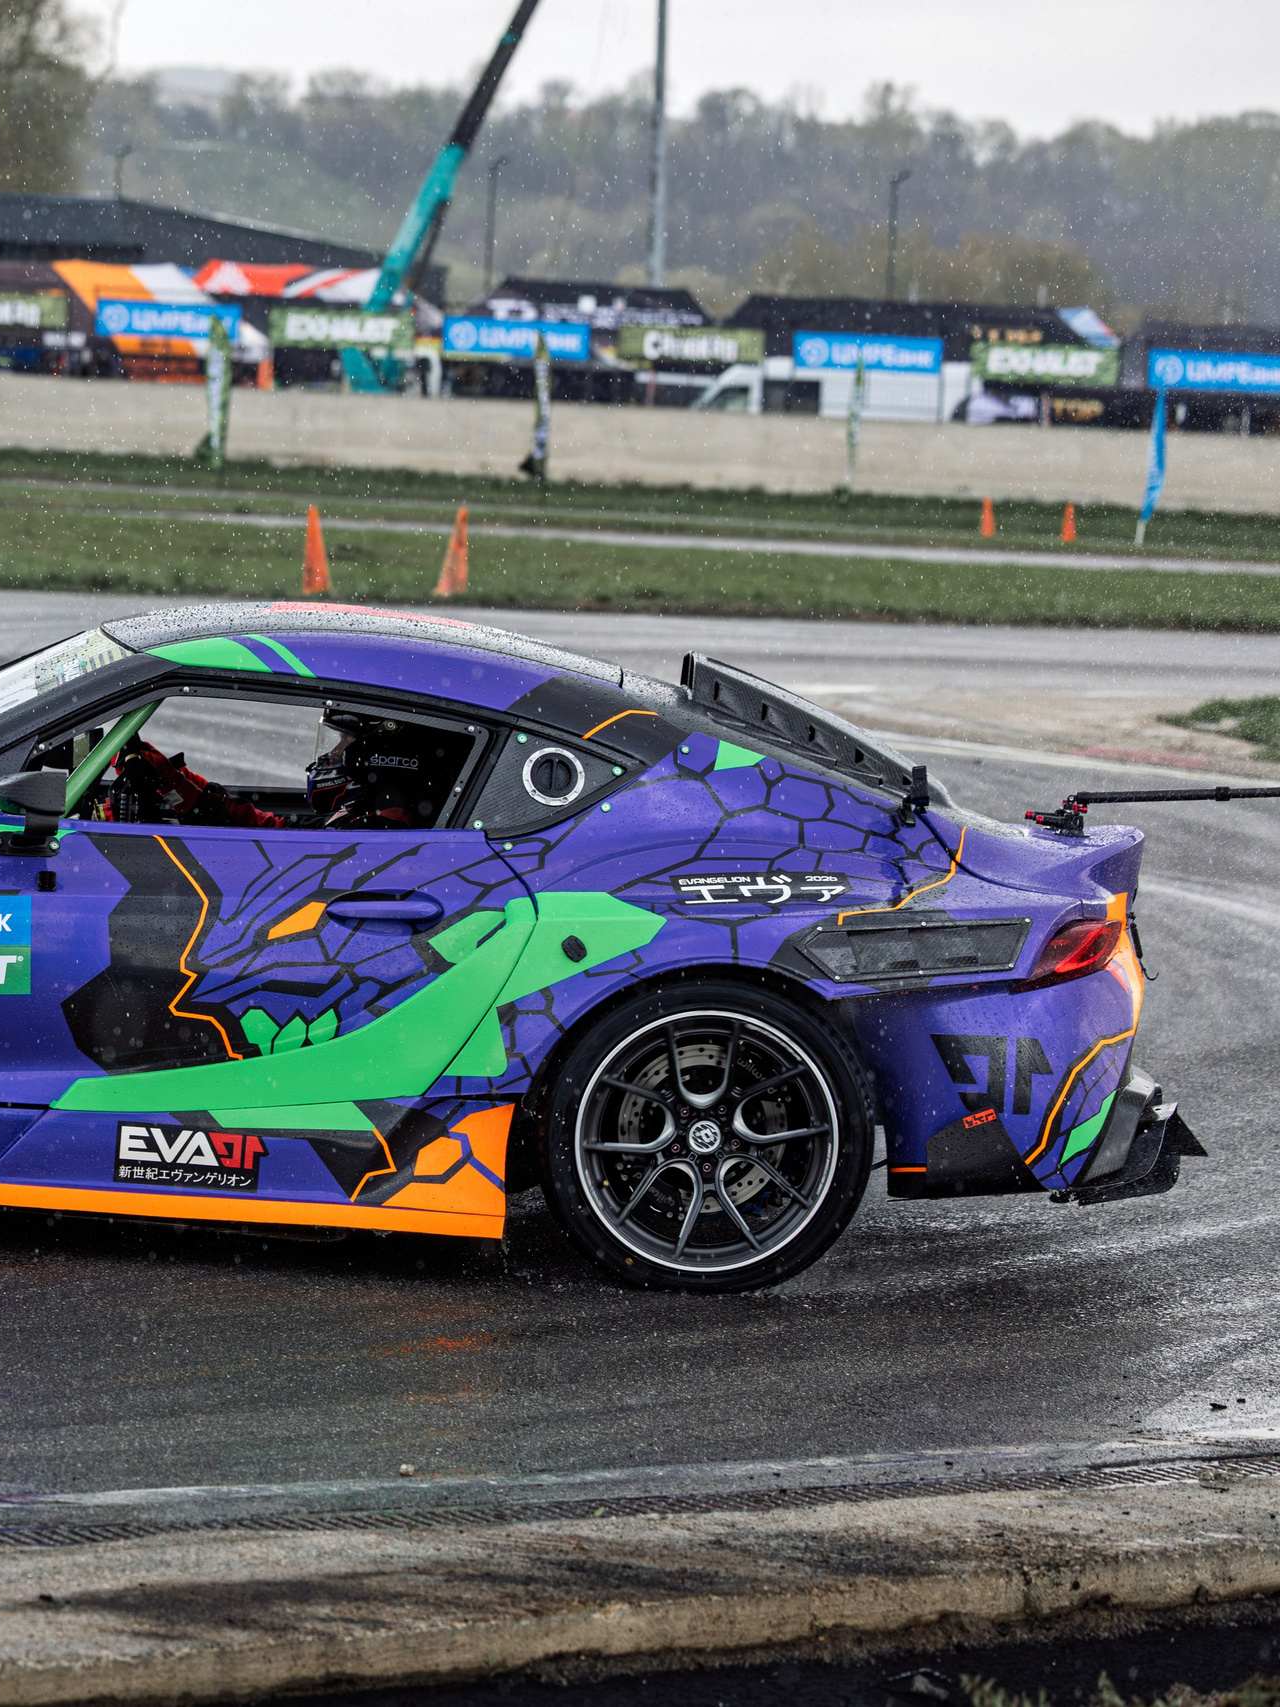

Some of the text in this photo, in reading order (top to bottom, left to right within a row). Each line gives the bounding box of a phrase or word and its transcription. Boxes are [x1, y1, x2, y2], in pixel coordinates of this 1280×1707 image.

[370, 755, 419, 768] sparco
[678, 875, 751, 886] EVANGELION
[680, 874, 846, 904] エヴァ
[118, 1165, 252, 1188] 新世紀エヴァンゲリオン
